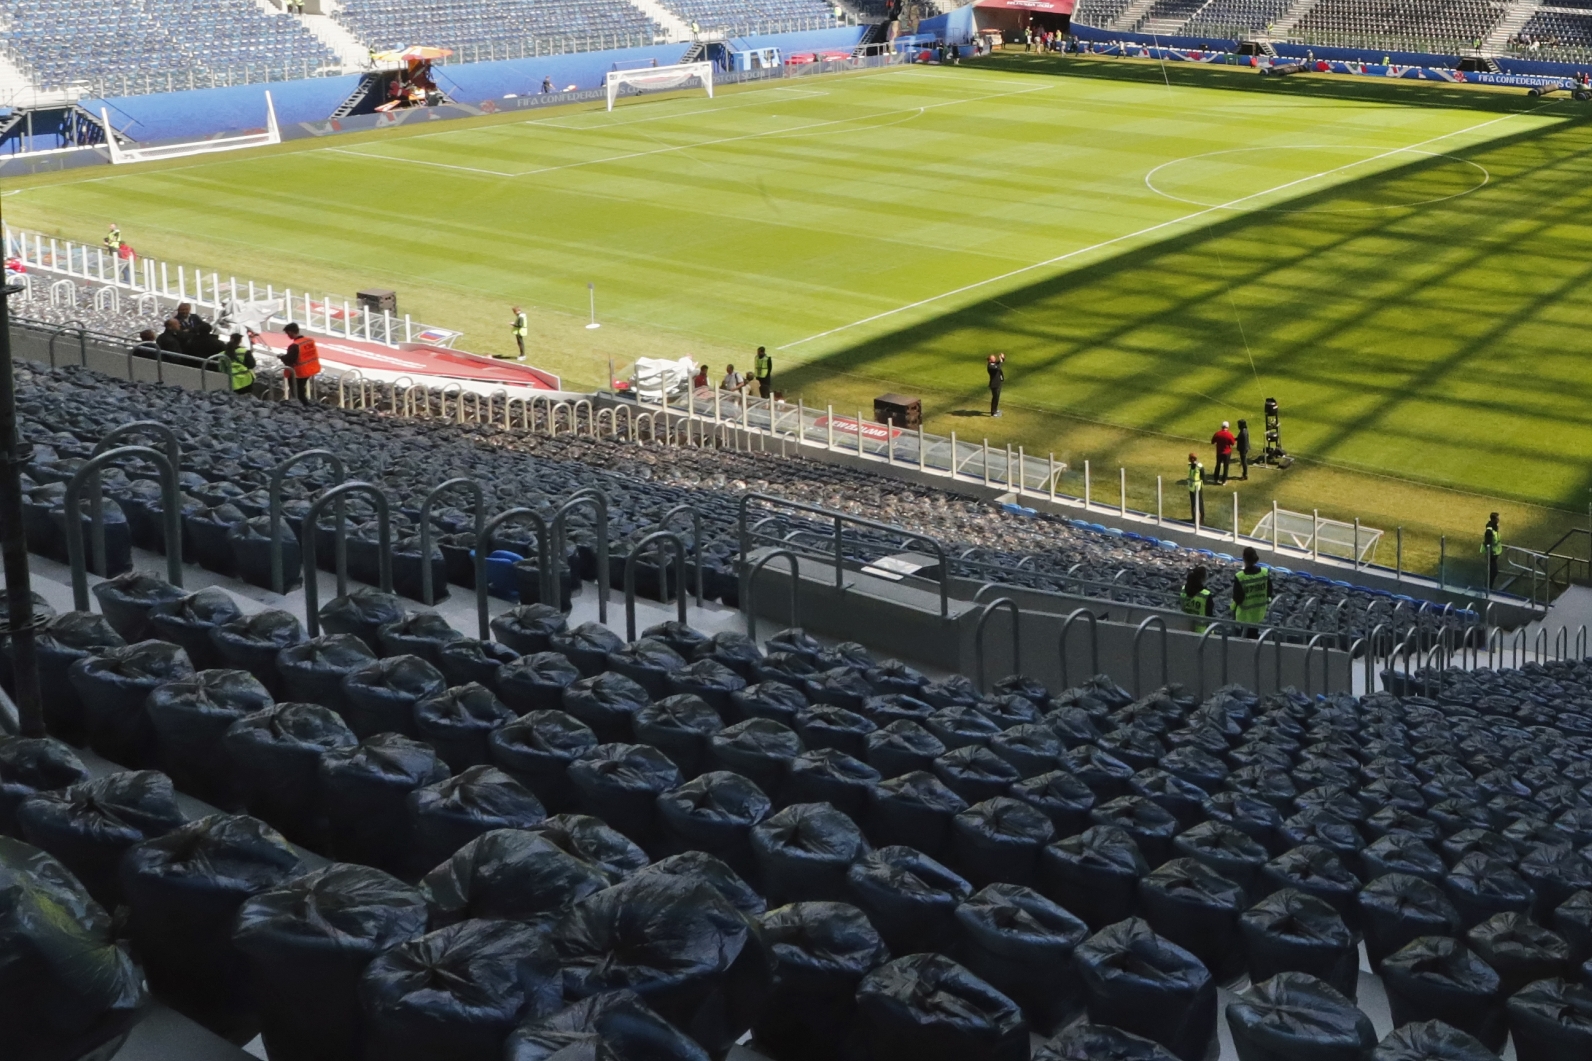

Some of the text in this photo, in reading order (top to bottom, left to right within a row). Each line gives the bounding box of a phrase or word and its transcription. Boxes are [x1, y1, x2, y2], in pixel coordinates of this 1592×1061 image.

[517, 98, 539, 107] FIFA
[681, 78, 699, 87] 2017
[741, 70, 766, 79] SOCHI
[1478, 74, 1495, 83] FIFA
[1496, 75, 1565, 88] CONFEDERATIONS
